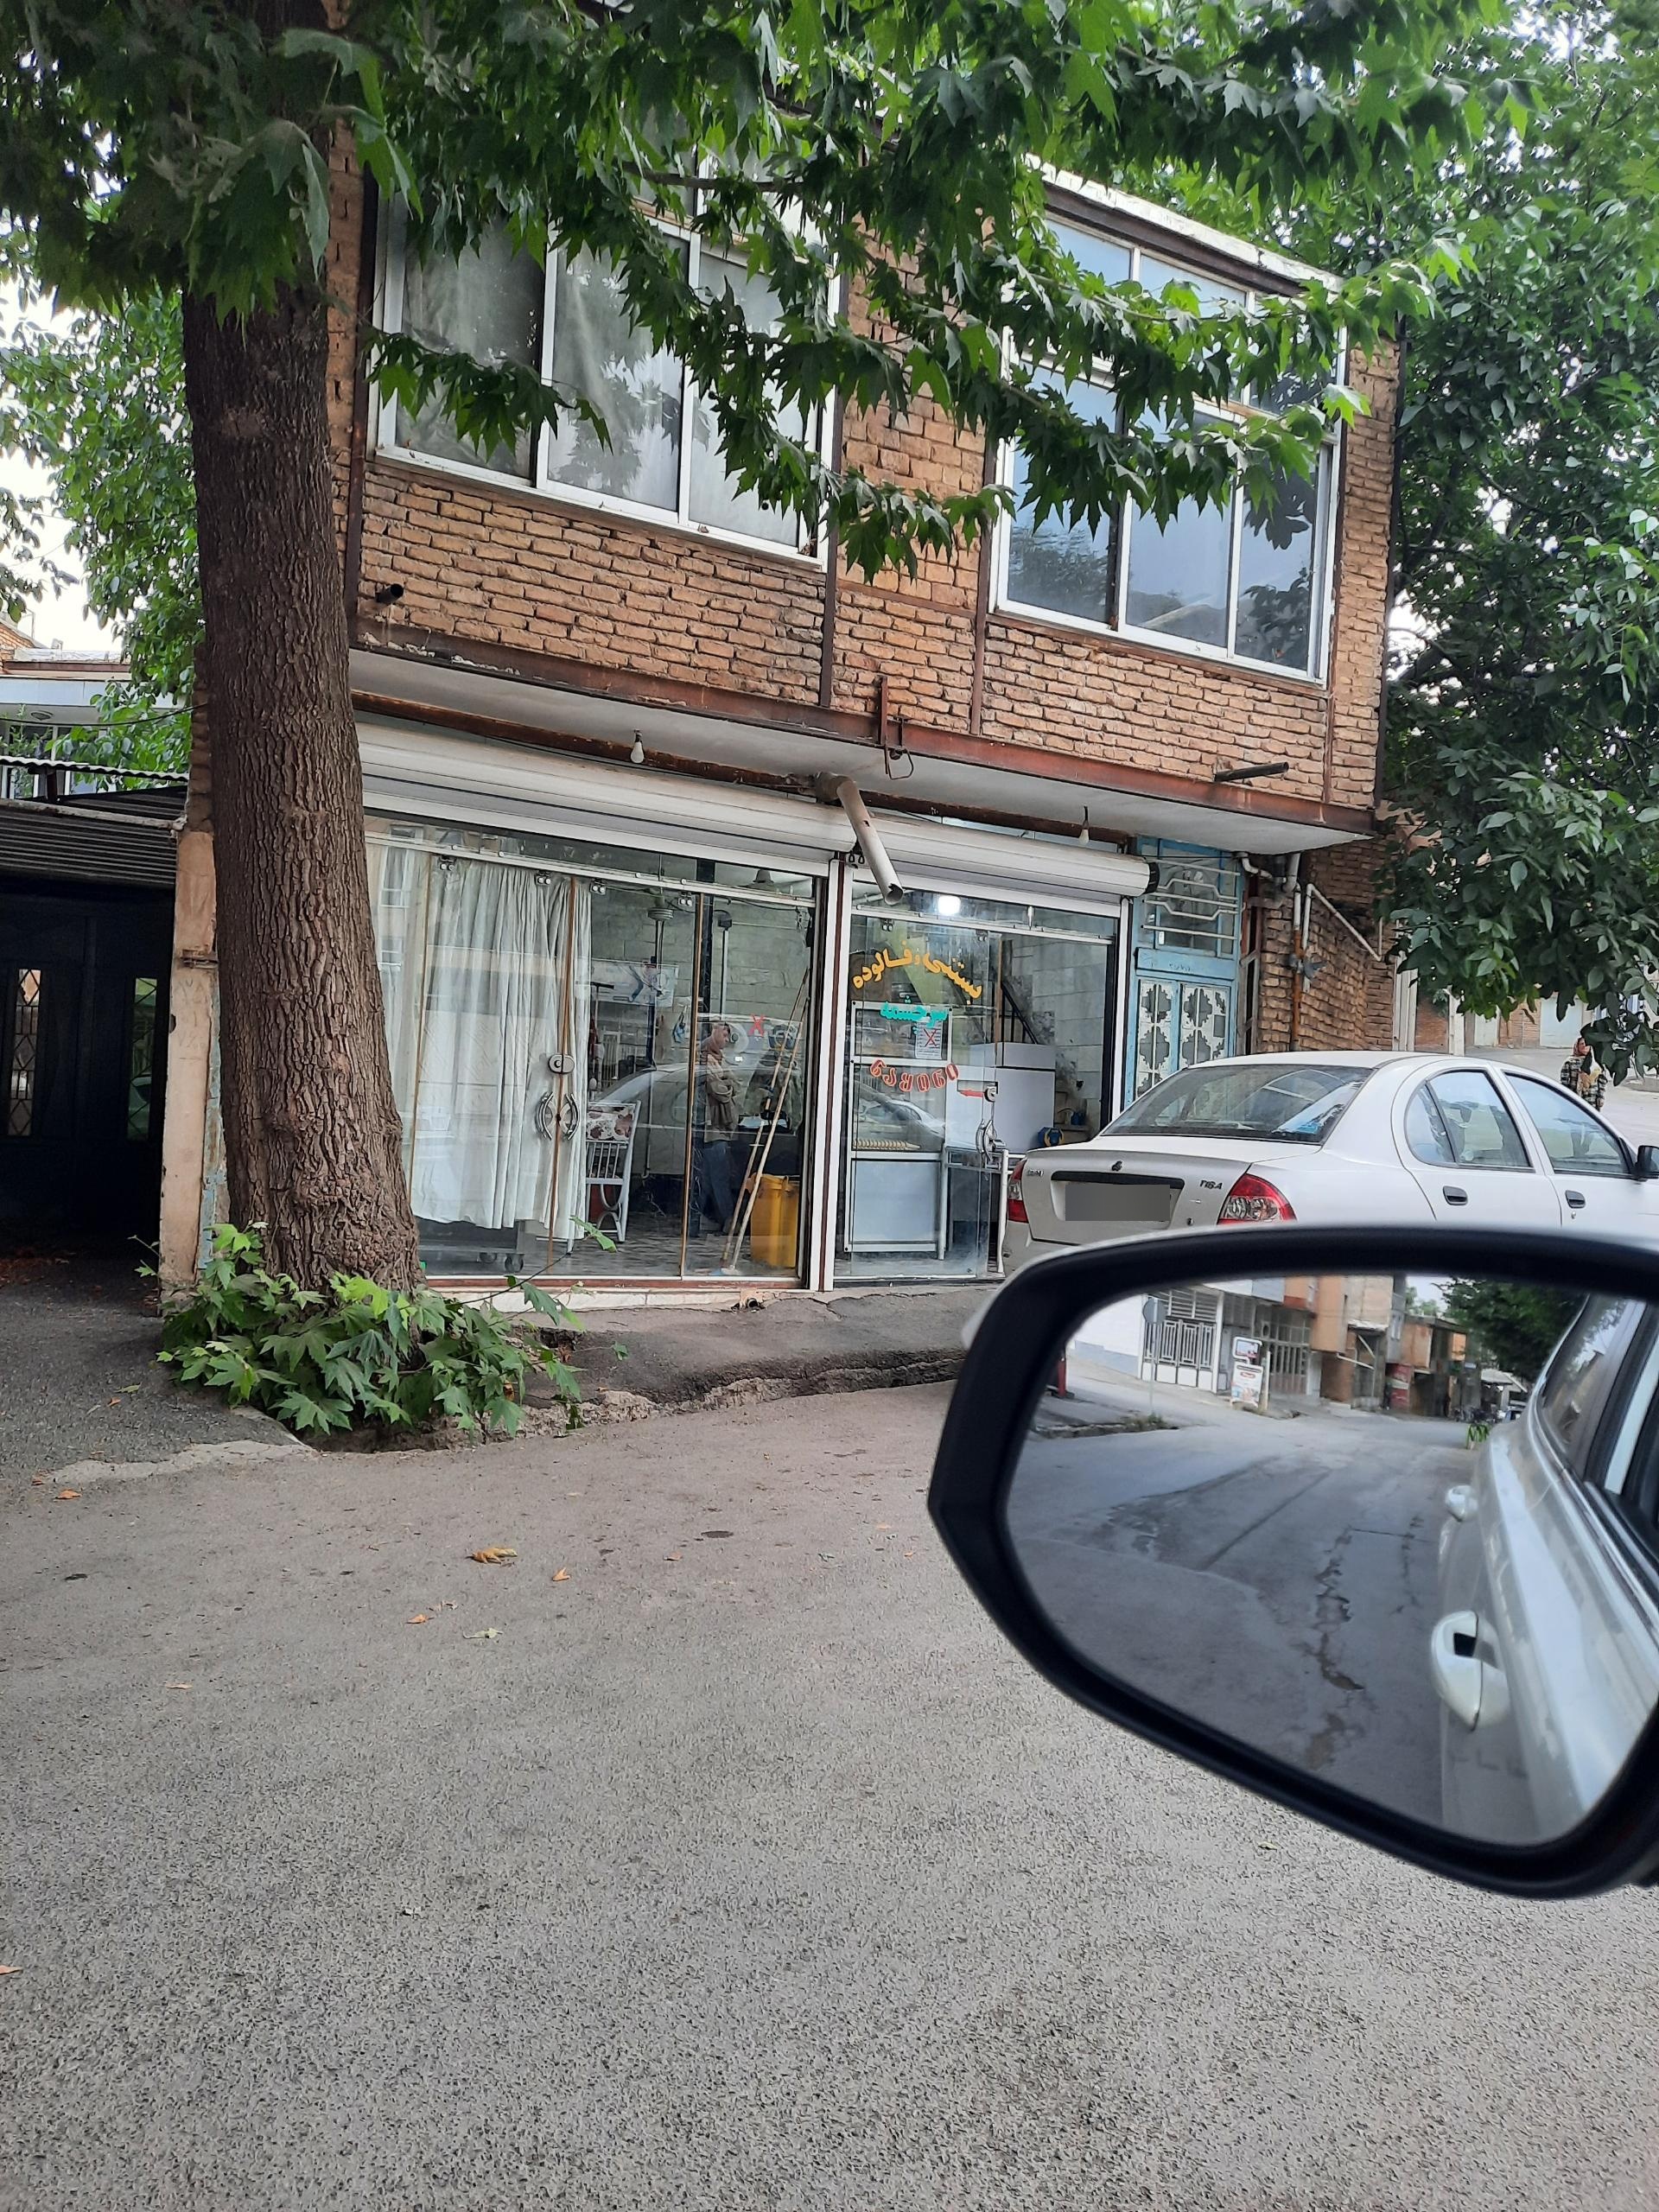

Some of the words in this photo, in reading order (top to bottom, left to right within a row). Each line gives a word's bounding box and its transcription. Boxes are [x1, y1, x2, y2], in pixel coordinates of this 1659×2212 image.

[852, 939, 913, 989] فالوده
[914, 954, 921, 965] و
[922, 952, 982, 1005] بستنی
